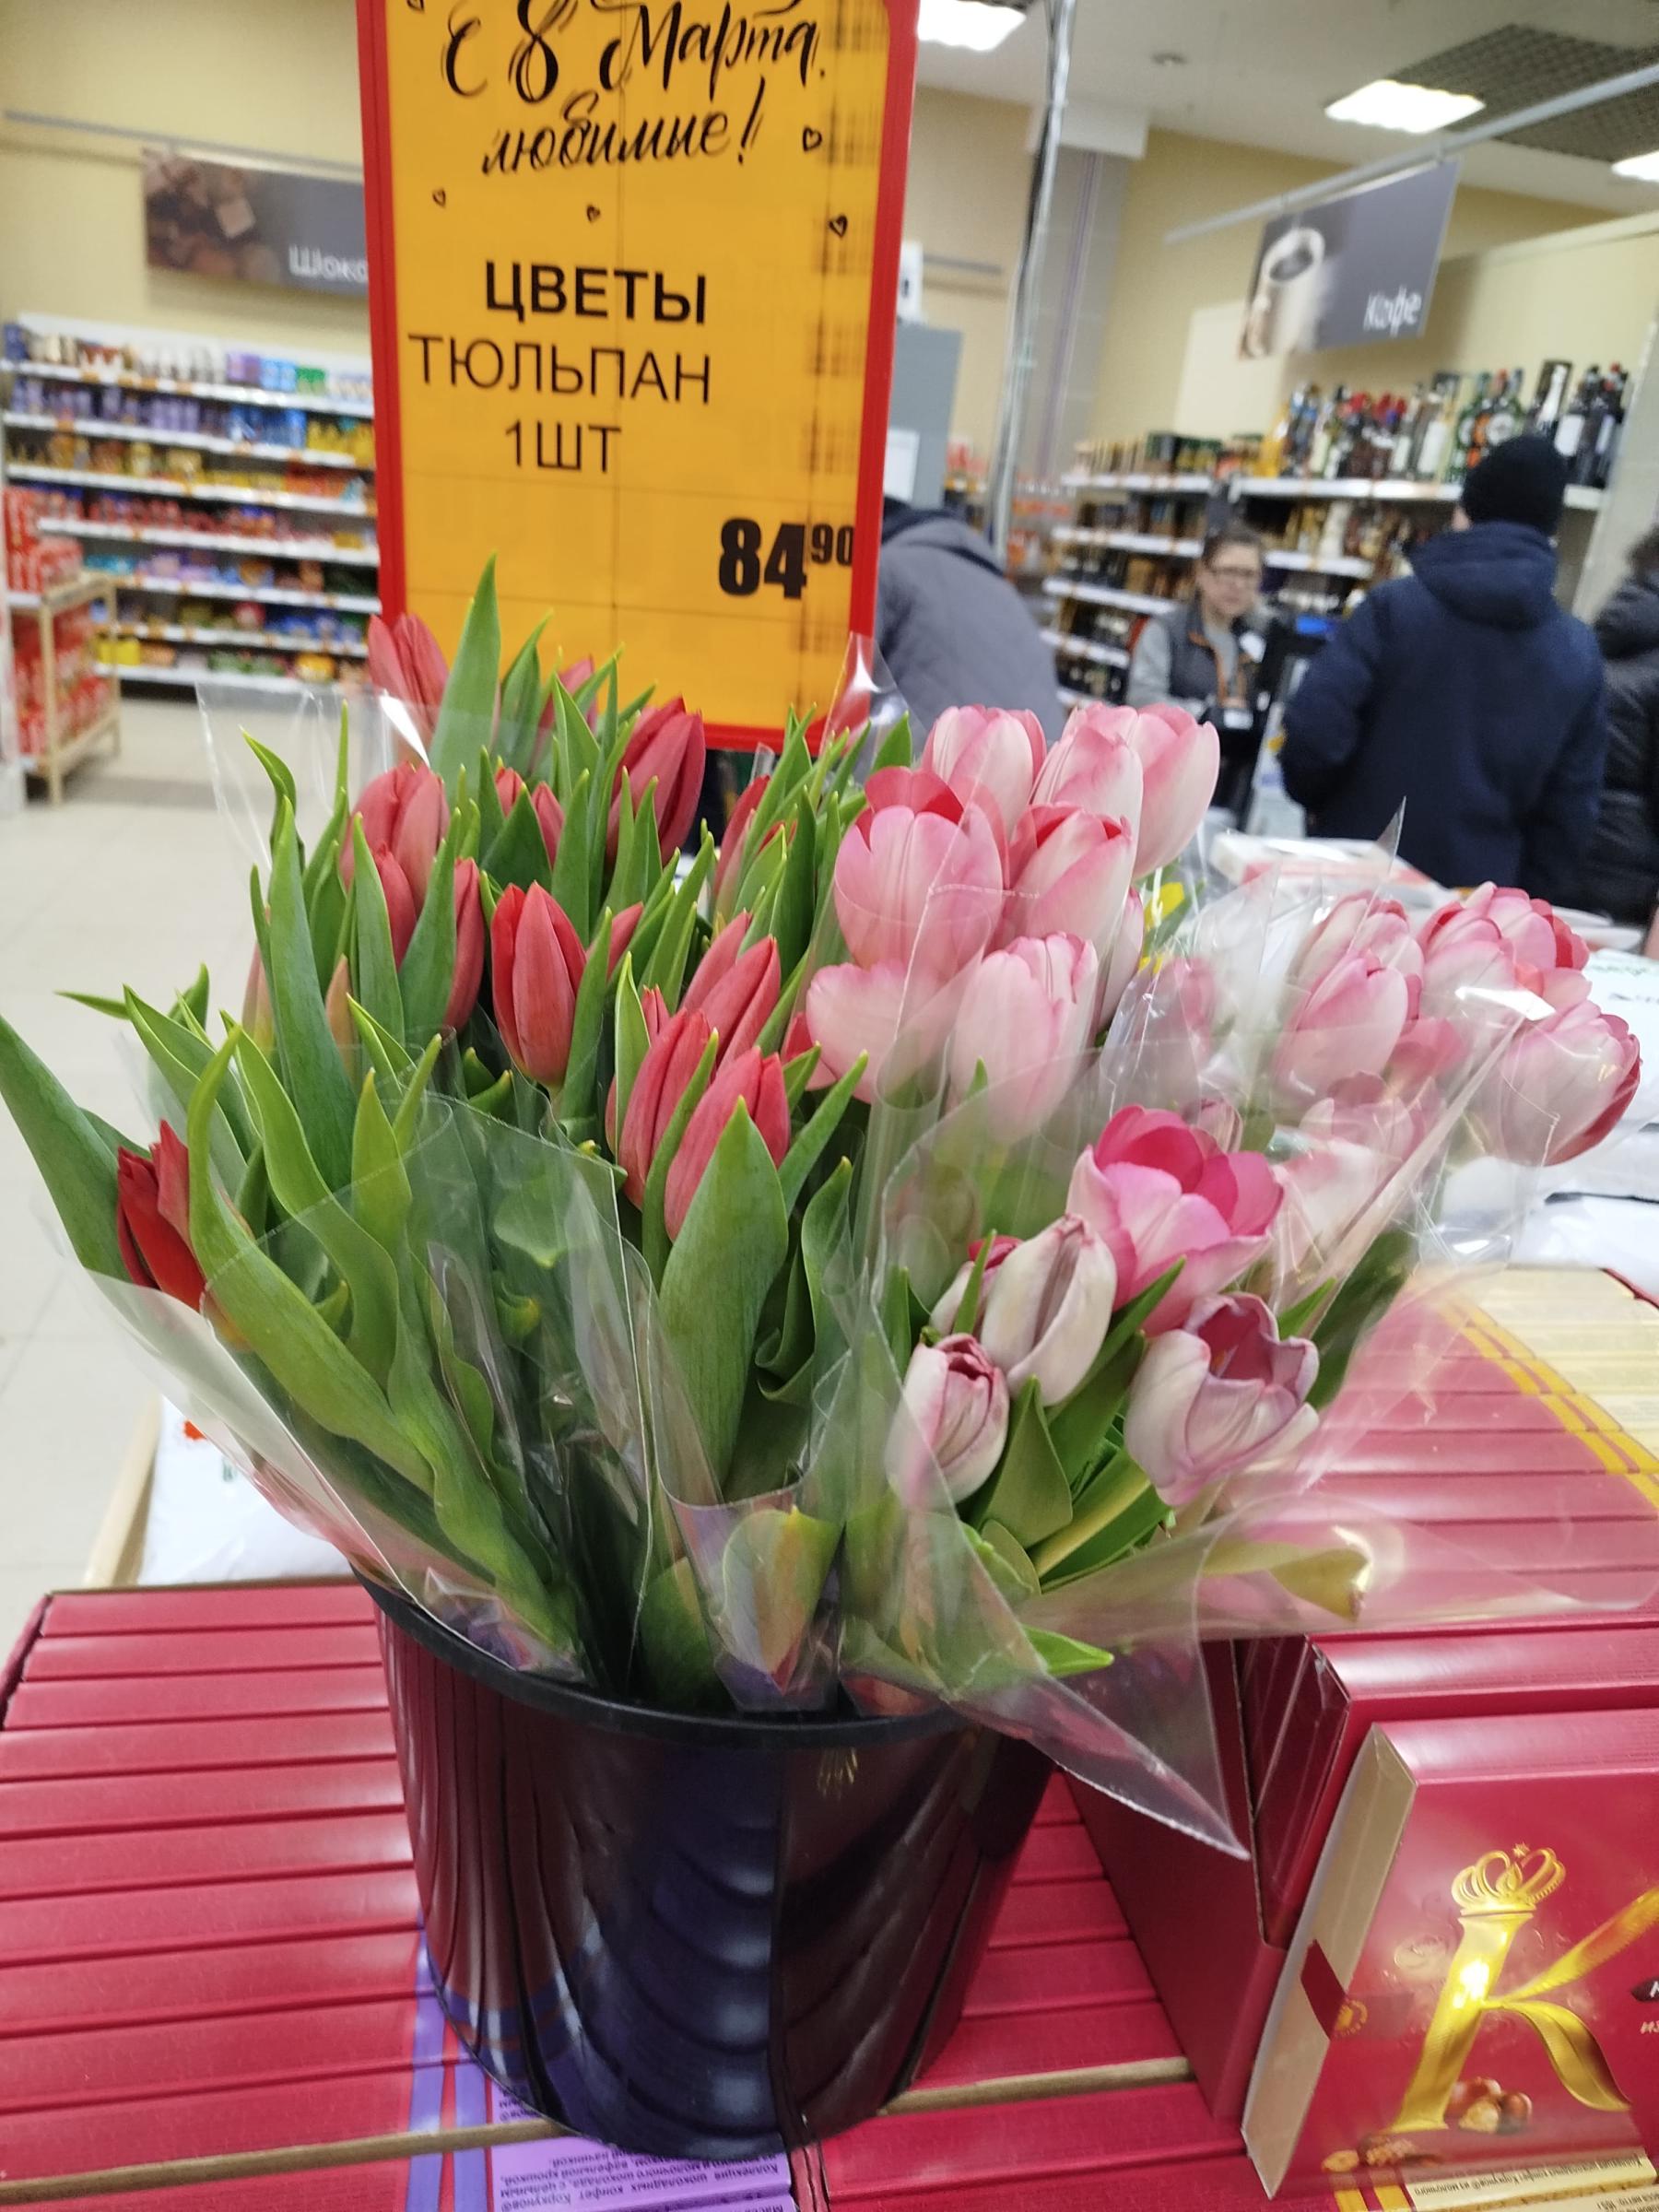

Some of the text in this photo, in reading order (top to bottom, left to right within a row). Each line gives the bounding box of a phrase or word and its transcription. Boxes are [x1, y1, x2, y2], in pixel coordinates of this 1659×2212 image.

[509, 0, 576, 104] 8
[485, 259, 707, 325] ЦВЕТЫ
[1363, 284, 1422, 339] Кофе
[407, 333, 711, 406] ТЮЛЬПАН
[504, 418, 622, 474] 1ШТ
[631, 2173, 709, 2192] шоколадных
[714, 2163, 779, 2181] Коллекция
